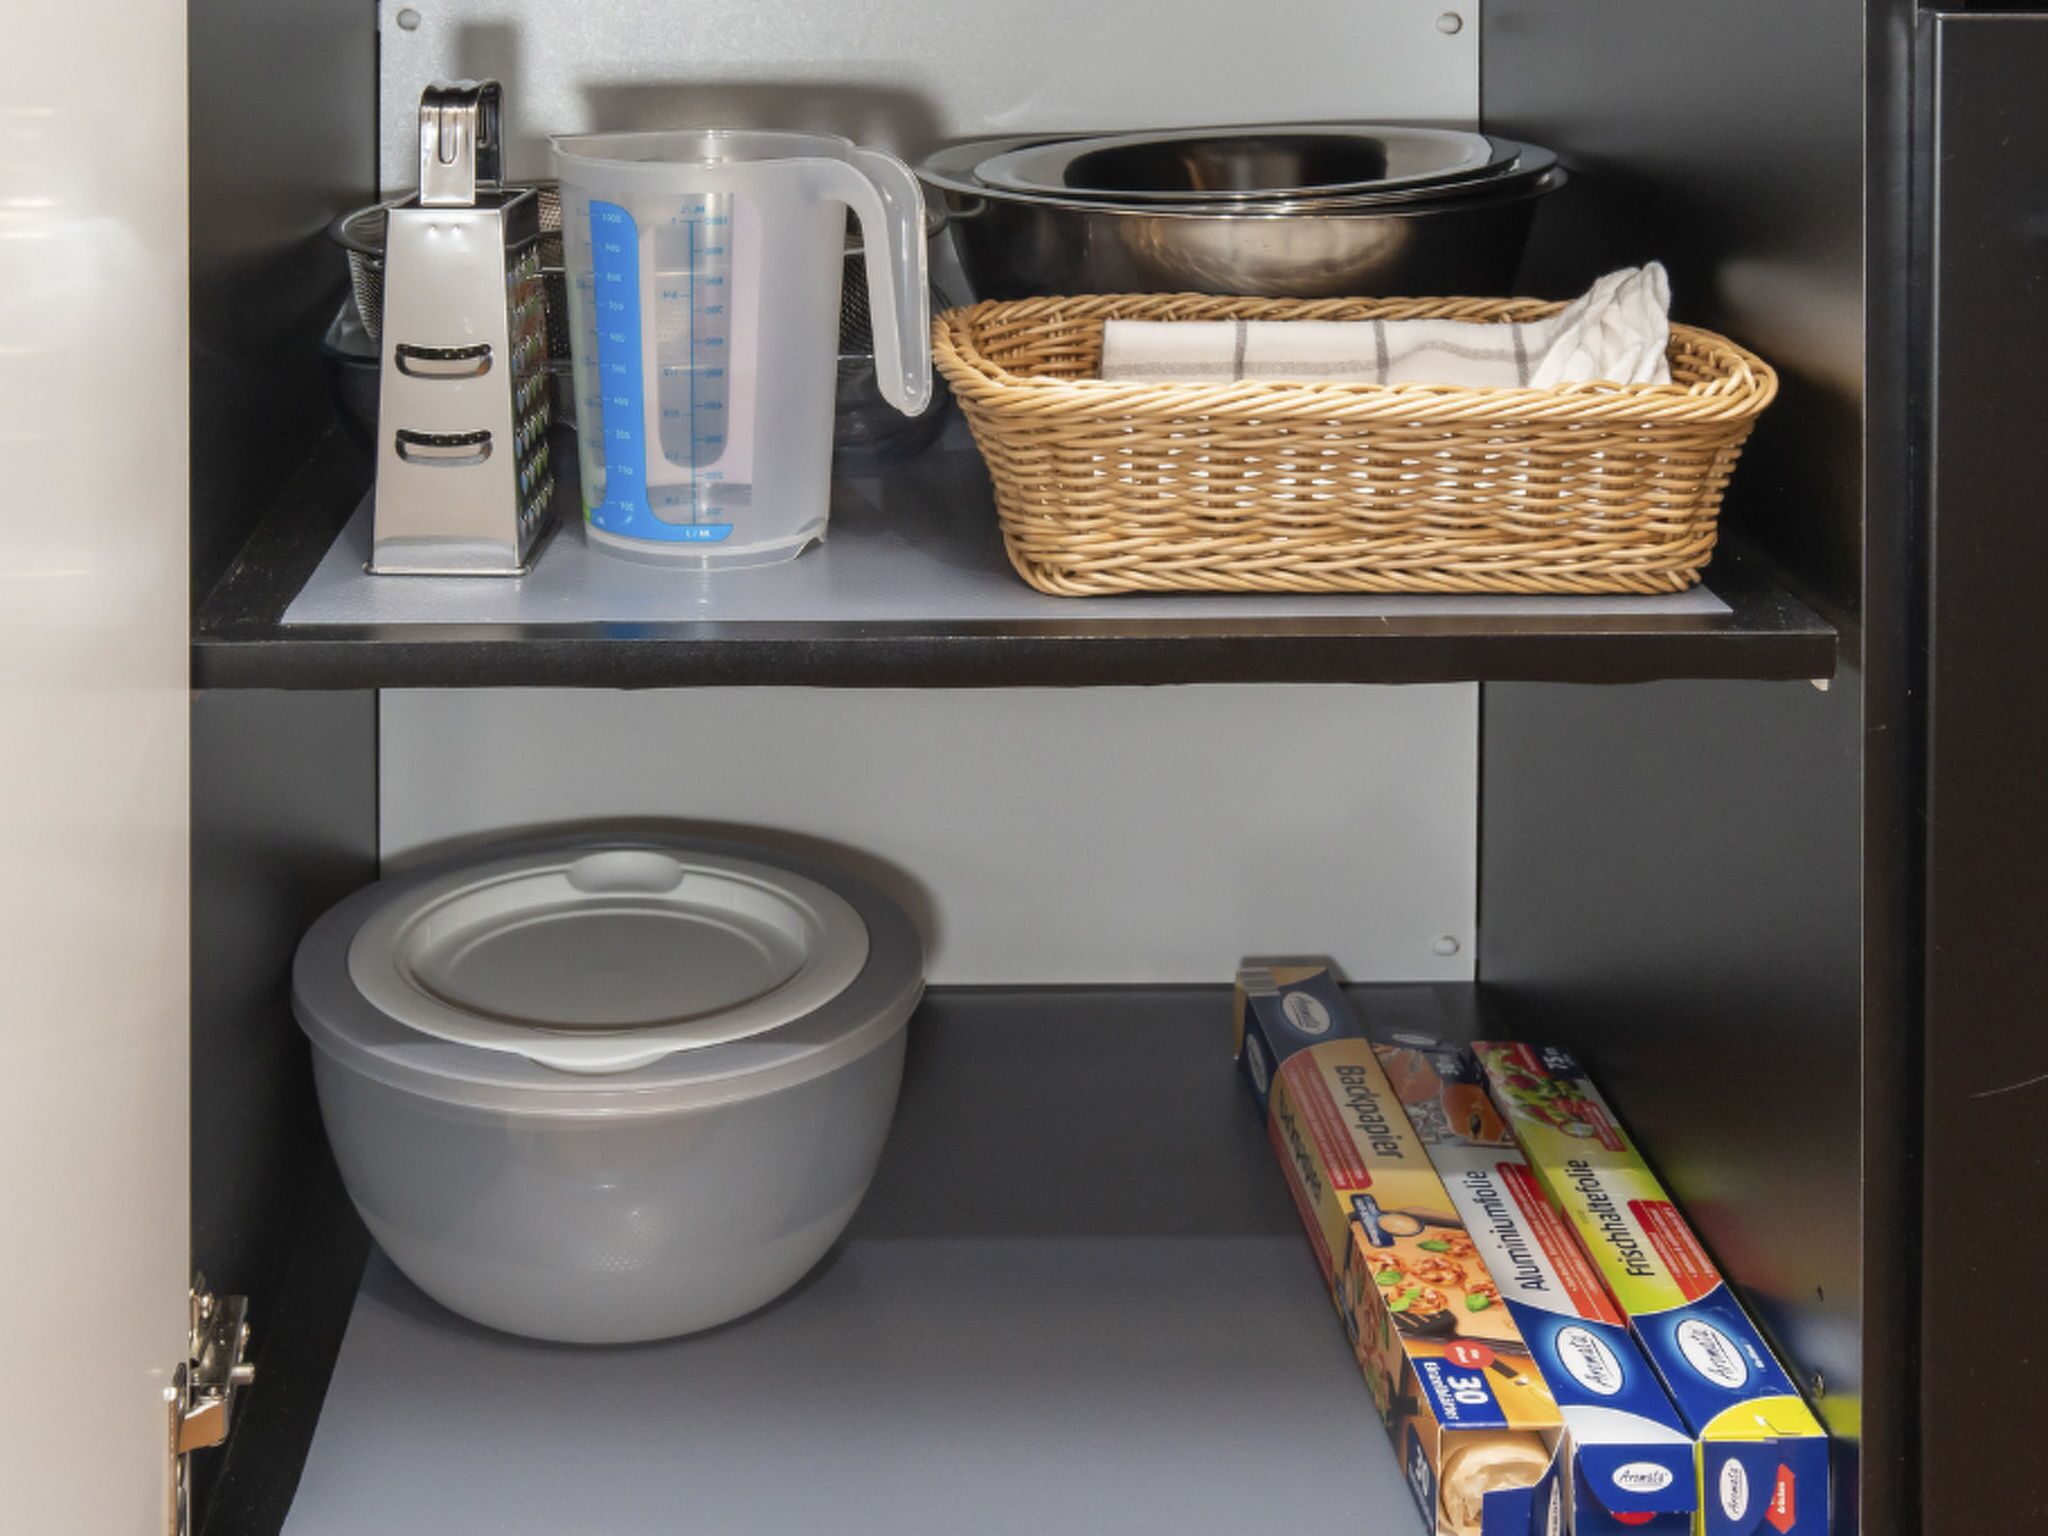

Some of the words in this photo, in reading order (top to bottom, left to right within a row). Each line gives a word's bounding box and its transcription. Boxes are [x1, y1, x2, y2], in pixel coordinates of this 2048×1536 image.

[1334, 1063, 1405, 1159] Backpapier
[1463, 1169, 1550, 1292] Aluminiumfolie
[1566, 1157, 1656, 1277] Frischhaltefolie
[1446, 1375, 1489, 1404] 30
